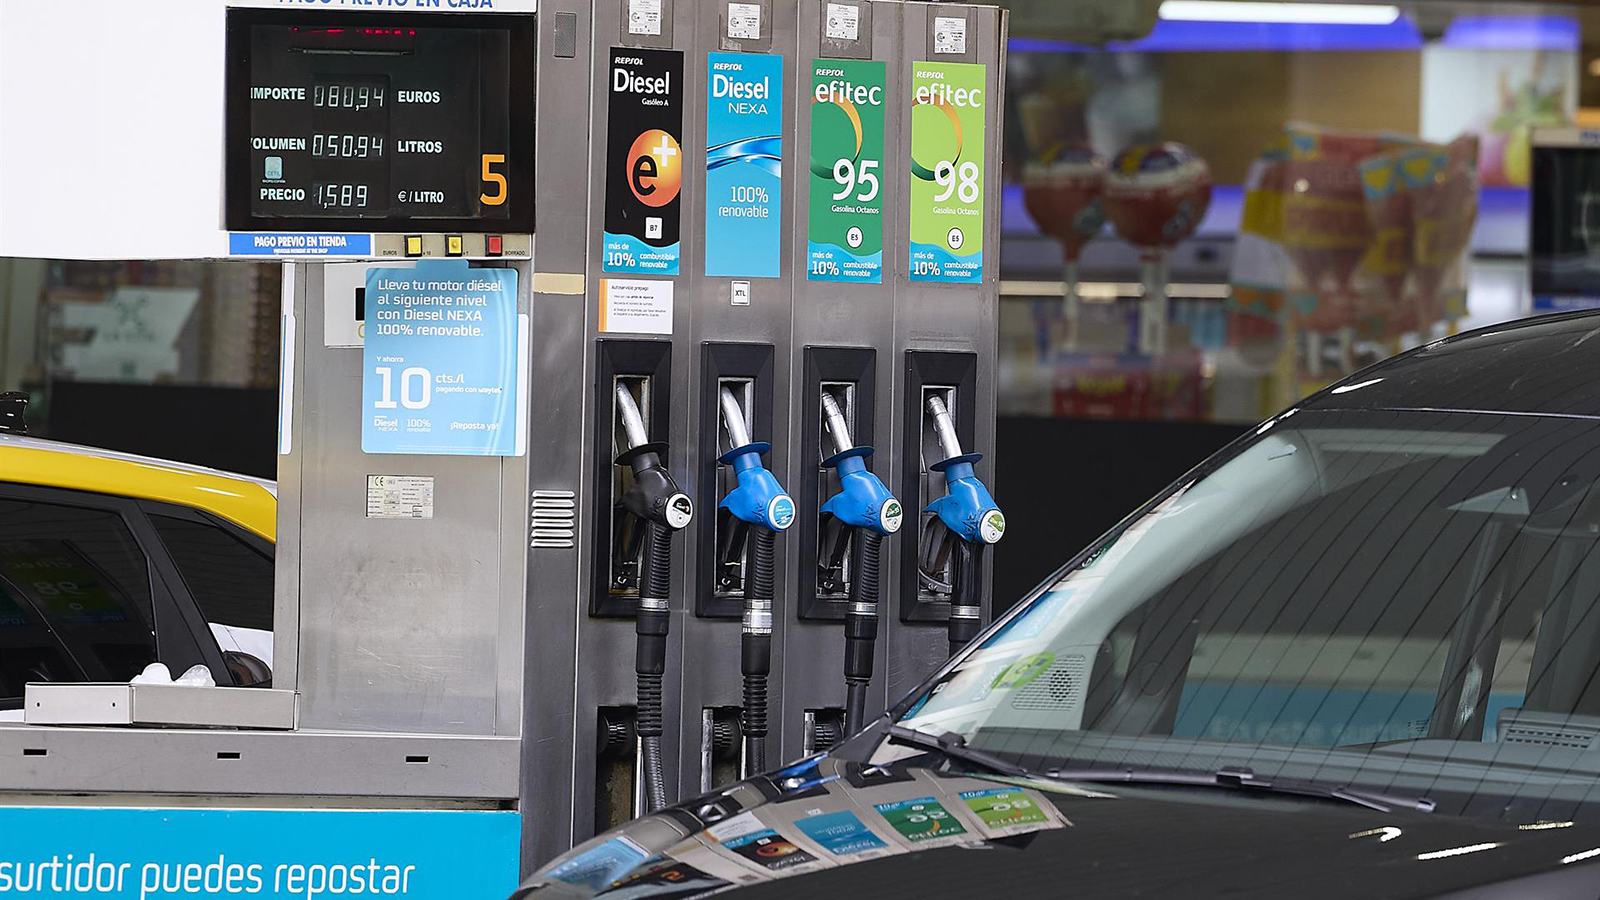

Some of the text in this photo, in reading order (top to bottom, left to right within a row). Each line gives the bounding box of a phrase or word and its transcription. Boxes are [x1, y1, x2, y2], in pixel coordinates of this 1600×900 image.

[615, 57, 644, 66] REPSOL
[714, 63, 743, 71] REPSOL
[816, 68, 845, 77] REPSOL
[916, 71, 945, 79] REPSOL
[614, 68, 670, 95] Diesel
[713, 74, 769, 100] Diesel
[251, 86, 441, 111] IMPORTE 080,94 EUROS
[815, 80, 882, 106] efitec
[916, 83, 982, 108] efitec
[642, 98, 669, 107] Gasóleo A
[728, 103, 768, 115] NEXA
[251, 135, 443, 157] OLUMEN 050,94 LITROS
[480, 154, 507, 206] 5
[833, 158, 879, 202] 95
[934, 161, 979, 204] 98
[260, 189, 305, 201] PRECIO
[318, 185, 368, 209] 1,589
[731, 186, 769, 203] 100%
[719, 205, 769, 218] renovable
[832, 205, 880, 214] Gasolina Octanos
[957, 208, 979, 216] Octanos
[254, 236, 347, 247] PAGO PREVIO EN TIENDA
[608, 242, 621, 250] más
[608, 252, 636, 267] 10%
[640, 253, 676, 261] combustible
[813, 251, 825, 259] más
[812, 261, 839, 276] 10%
[914, 262, 940, 276] 10%
[944, 262, 979, 270] combustible
[378, 279, 503, 291] Lleva tu motor diésel
[378, 294, 487, 308] al siguiente nivel
[377, 309, 483, 321] con Diesel NEXA
[377, 324, 414, 335] 100%
[417, 325, 484, 336] renovable.
[374, 367, 431, 409] 10
[374, 419, 398, 427] Diesel
[407, 419, 431, 428] 100%
[451, 422, 486, 431] ¡Reposta
[0, 853, 416, 900] surtidor puedes repostar
